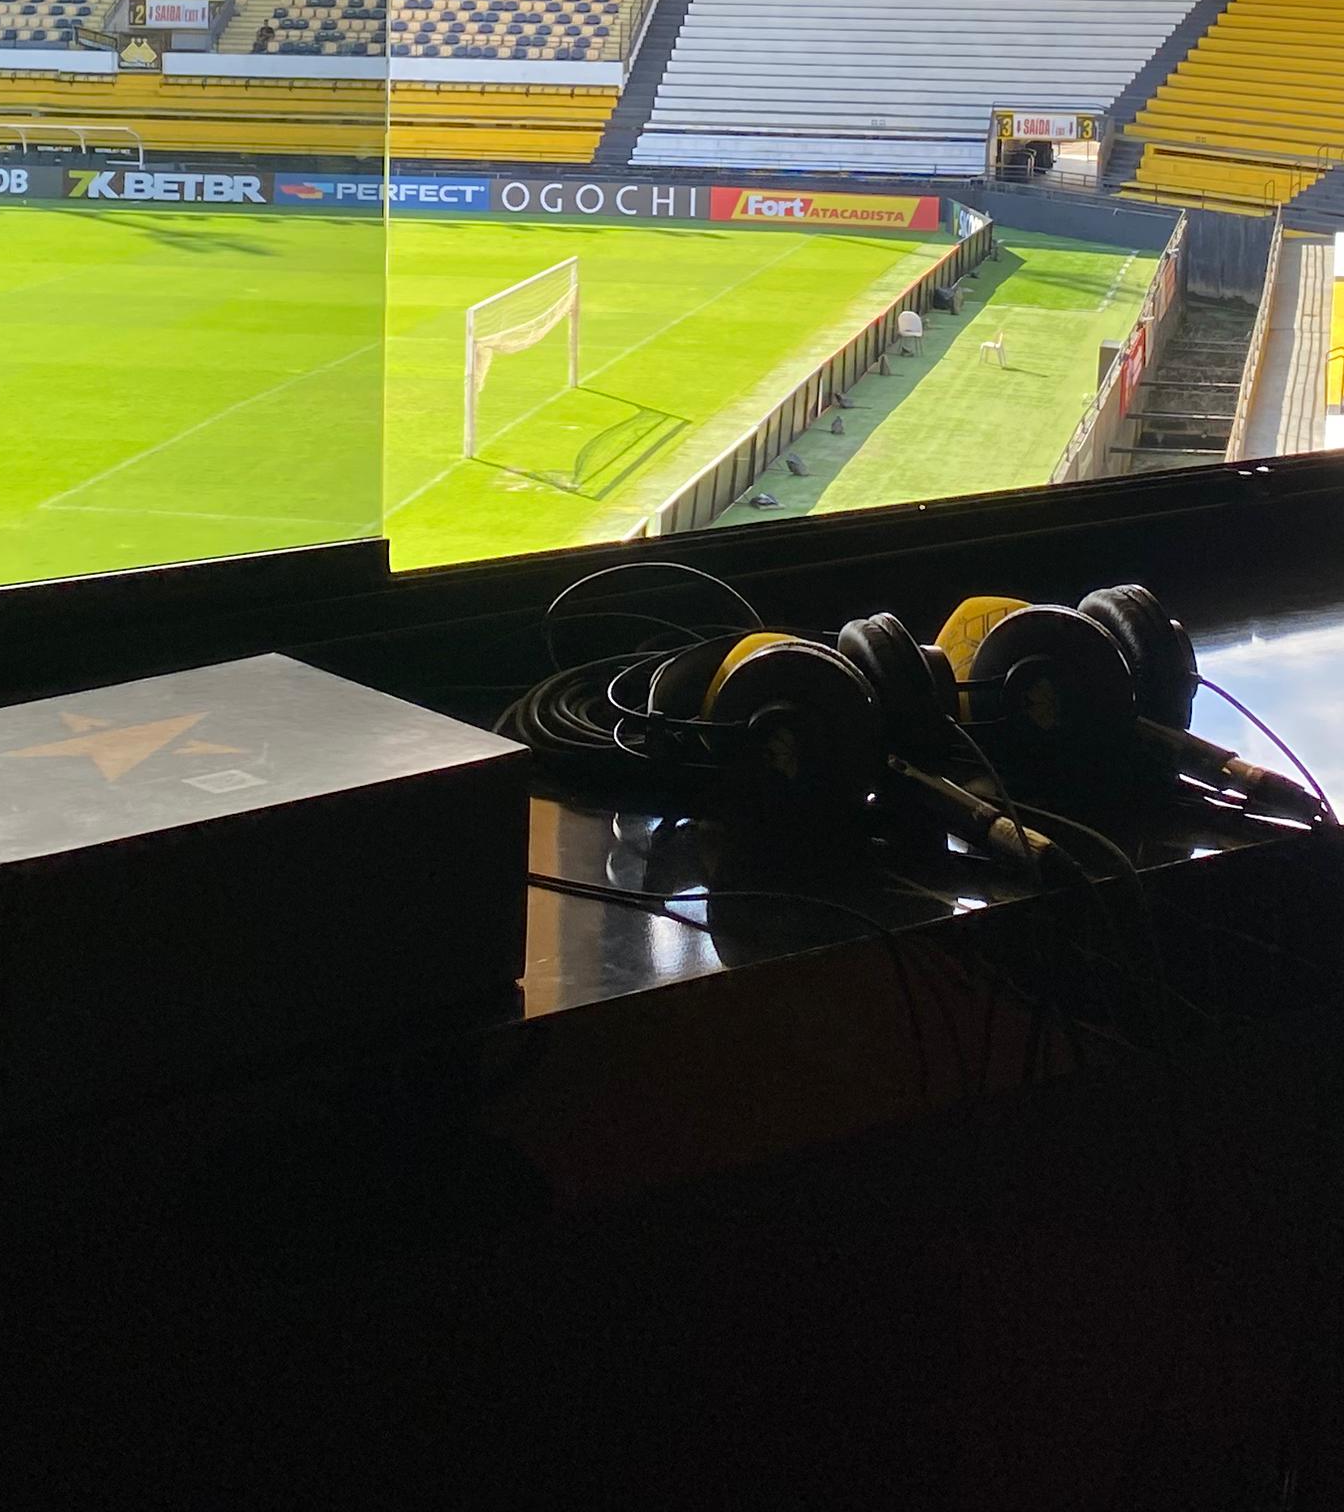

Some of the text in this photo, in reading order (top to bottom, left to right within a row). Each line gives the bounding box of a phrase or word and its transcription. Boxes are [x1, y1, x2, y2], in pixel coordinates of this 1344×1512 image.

[336, 182, 480, 204] PERFECT
[501, 181, 697, 216] OGOCHI
[747, 195, 905, 222] Fort ATACADISTA
